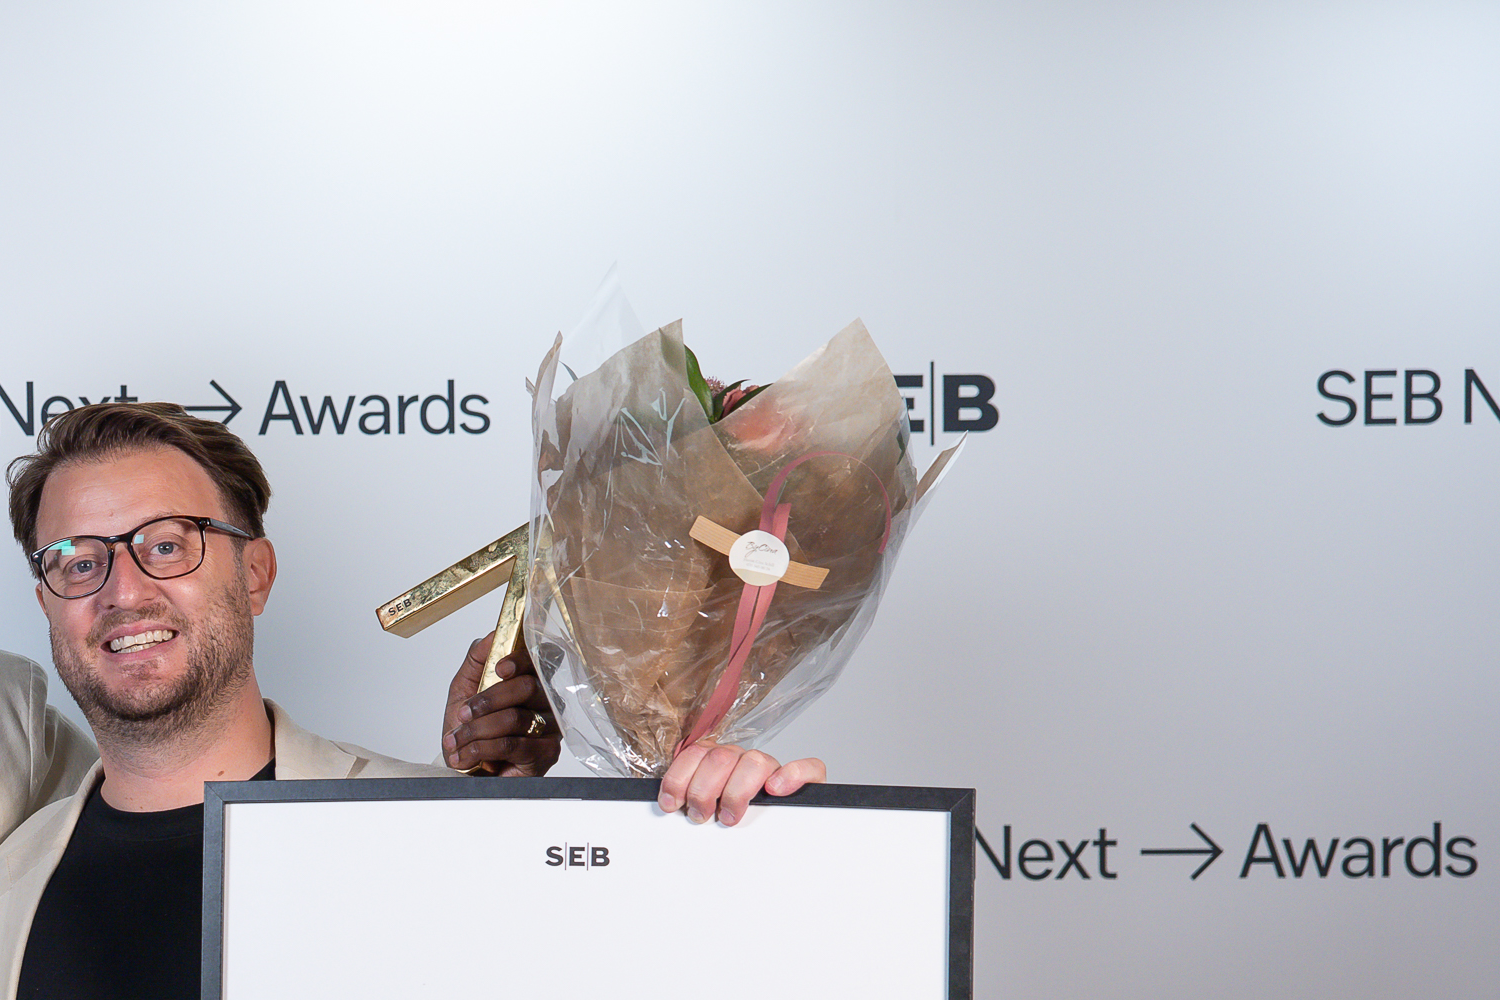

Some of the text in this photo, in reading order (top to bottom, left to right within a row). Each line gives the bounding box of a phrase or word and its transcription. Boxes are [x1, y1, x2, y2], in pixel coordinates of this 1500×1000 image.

[259, 380, 490, 435] Awards
[1317, 370, 1442, 426] SEB
[975, 822, 1477, 881] Next Awards
